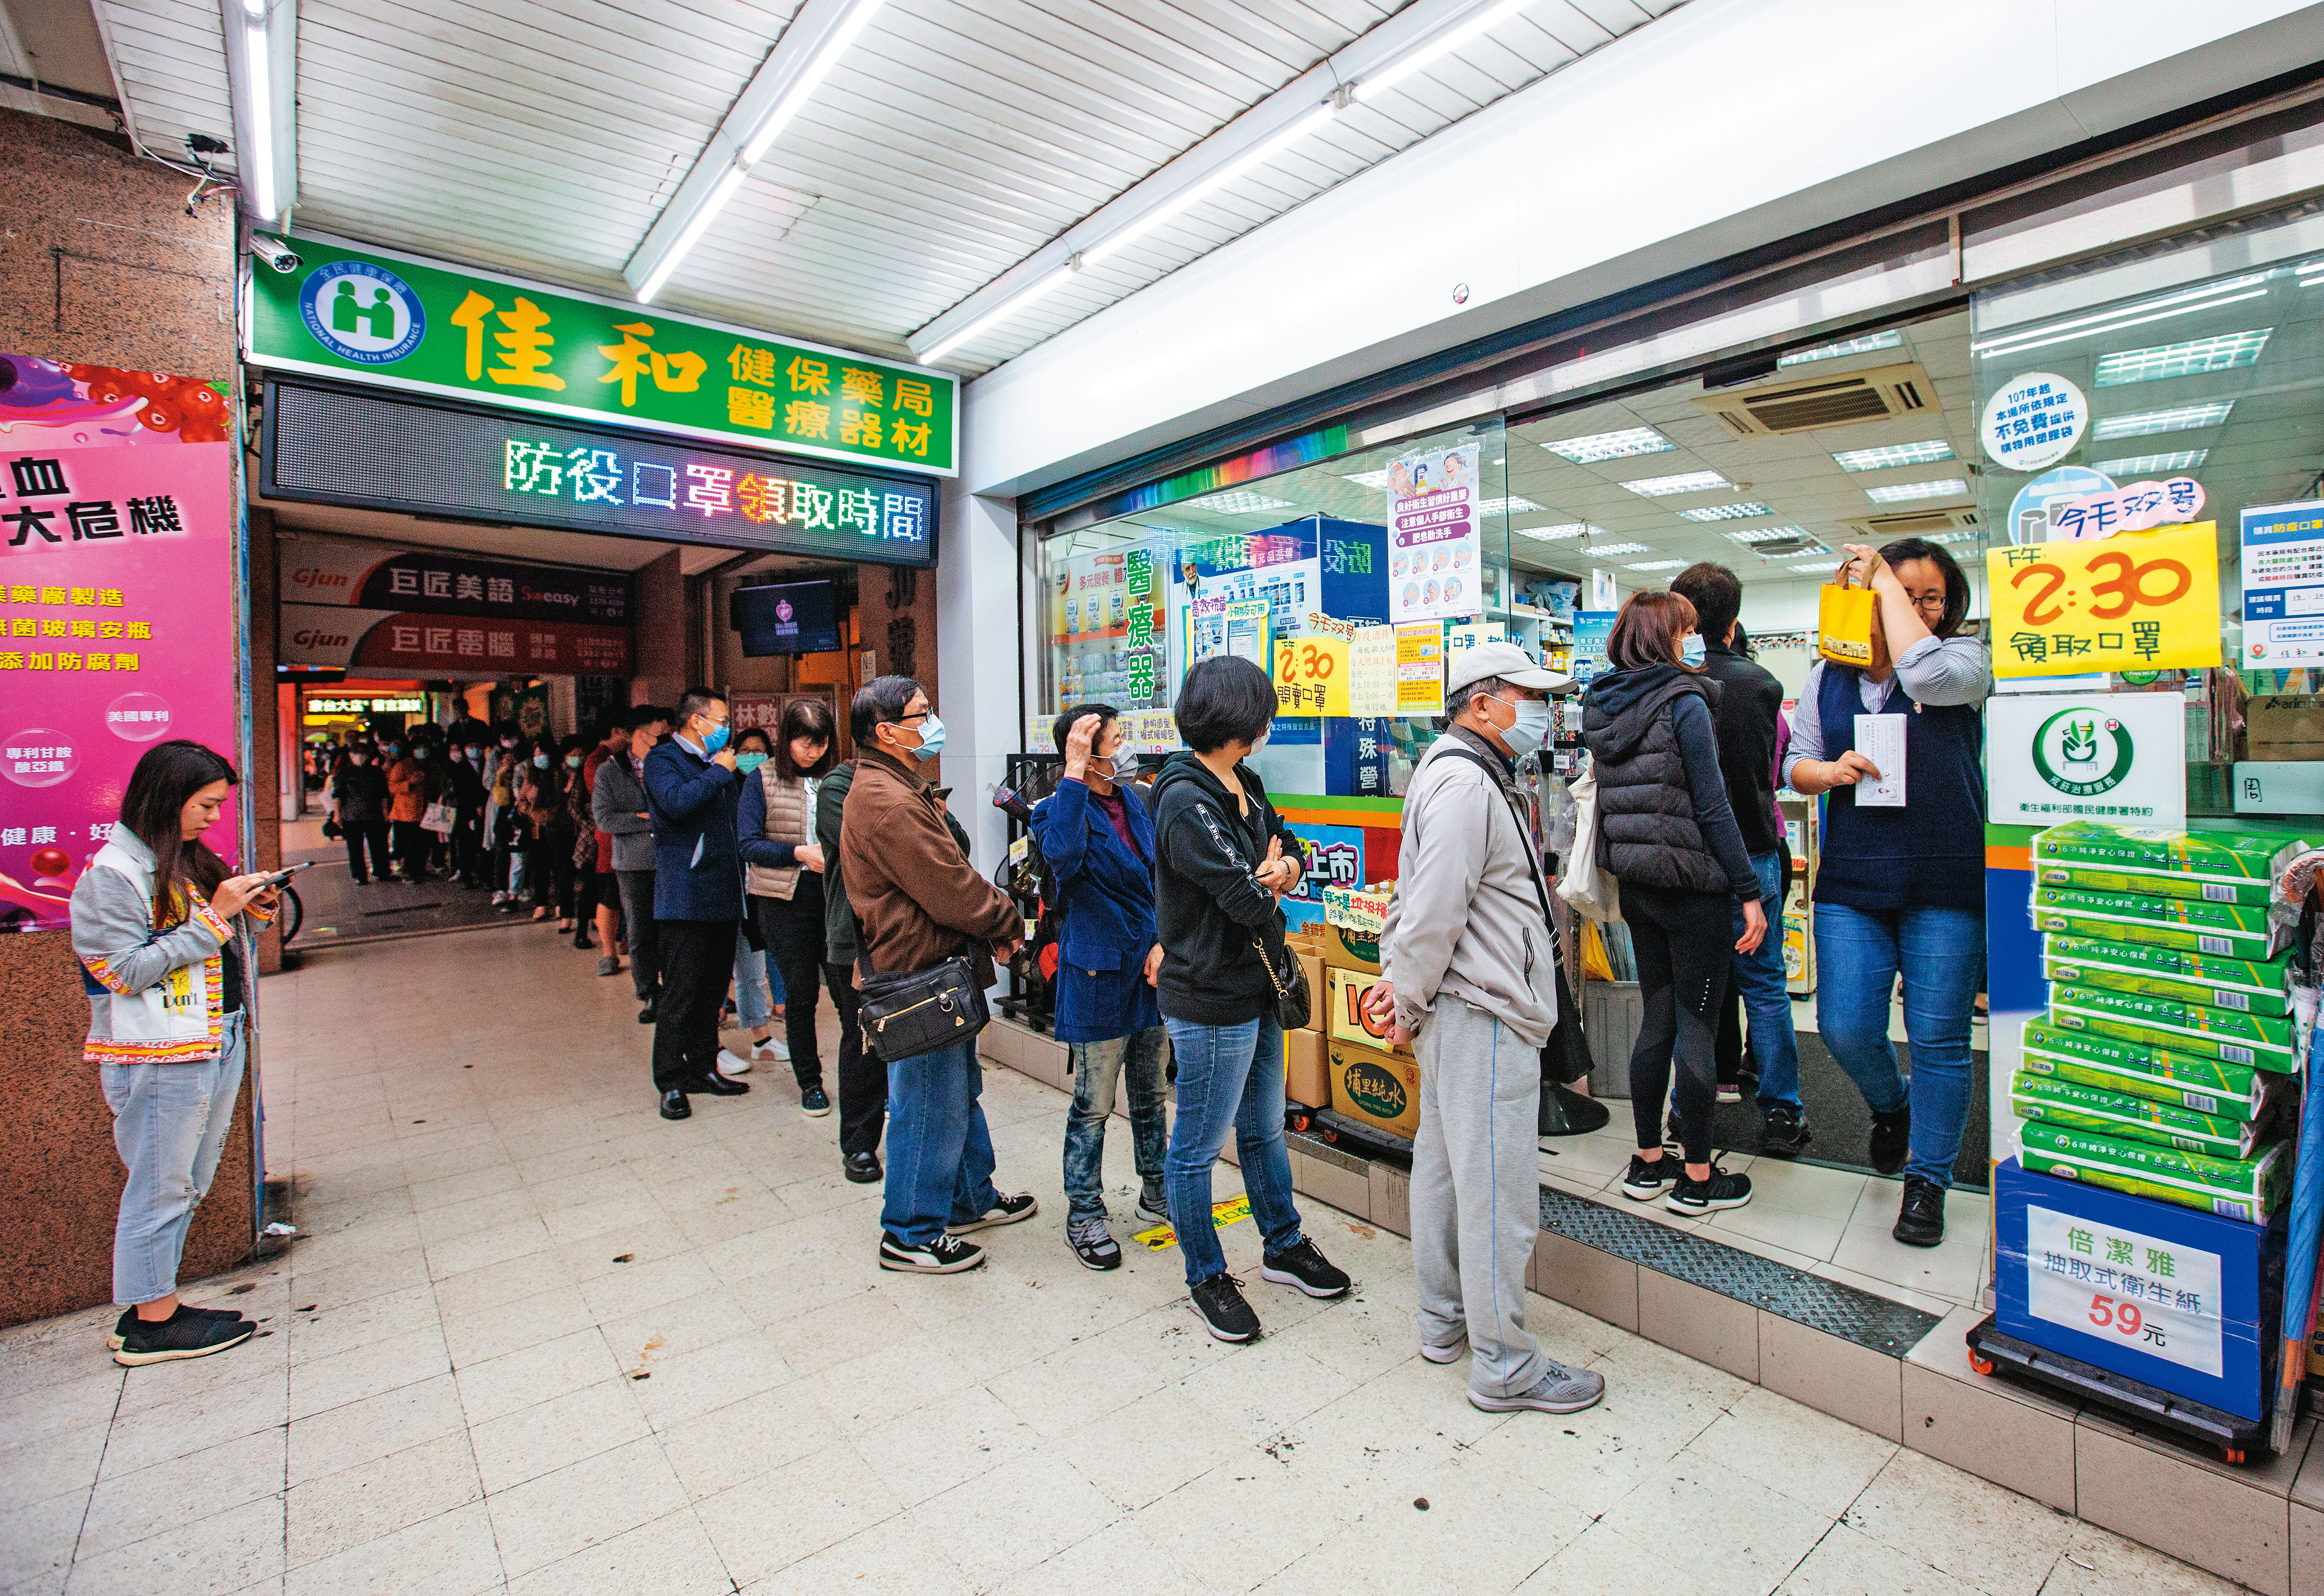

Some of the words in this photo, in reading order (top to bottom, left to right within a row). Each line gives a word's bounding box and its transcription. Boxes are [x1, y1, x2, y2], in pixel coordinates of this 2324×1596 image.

[304, 301, 335, 348] NATIONAL
[337, 345, 380, 361] HEALTH
[382, 322, 421, 361] INSURANCE
[451, 289, 707, 407] 佳和
[727, 343, 933, 417] 健保藥局
[2008, 383, 2051, 404] 107年起
[1996, 392, 2068, 422] 本場所依規定
[726, 386, 932, 456] 醫療器材
[1994, 410, 2076, 441] 不免費提供
[2001, 425, 2073, 454] 購物用塑膠袋
[0, 457, 70, 499] 血
[506, 438, 923, 542] 防役口罩領取時間
[1397, 488, 1467, 513] 良好衛生習慣好重要
[1, 496, 183, 547] 大危機
[1401, 507, 1464, 529] 注意個人手部衛生
[1413, 526, 1452, 543] 肥皂勤洗手
[2258, 545, 2324, 557] 因本藥局有配合鄰近
[2259, 554, 2324, 565] 各大醫院處方箋領藥
[292, 568, 347, 590] Gjun
[390, 567, 514, 603] 巨匠美語
[1079, 570, 1109, 590] 多元營養
[2258, 572, 2324, 582] 或離峰時段購買防疫
[0, 585, 124, 607] 藥廠製造
[2011, 551, 2192, 626] 2:30
[1192, 595, 1226, 617] 高效抗菌
[1227, 603, 1265, 618] 小朋友可用
[0, 619, 152, 640] 菌玻璃安瓶
[293, 629, 349, 650] Gjun
[1127, 548, 1154, 710] 醫療器
[391, 626, 515, 657] 巨匠電腦
[2009, 621, 2161, 663] 領取口罩
[0, 652, 140, 671] 添加防腐劑
[1279, 644, 1334, 683] 2:30
[1277, 682, 1326, 712] 開賣口罩
[107, 710, 169, 722] 美國專利
[1143, 718, 1171, 729] 動物造型
[6, 746, 72, 760] 專利甘胺
[1358, 717, 1379, 798] 特殊營
[2048, 776, 2117, 796] 戒菸治療服務
[2019, 802, 2154, 817] 衛生福利部國民健康署特約
[1209, 824, 1219, 840] NIKE
[2062, 845, 2136, 858] 6項純淨安心保證
[1307, 846, 1354, 882] 上市
[2060, 893, 2133, 908] 6項純淨安心保證
[2073, 942, 2148, 961] 6項純淨安心保證
[163, 992, 198, 1009] Don't
[2078, 992, 2154, 1013] 6項純淨安心保證
[2049, 1036, 2120, 1058] 6項純淨安心保證
[1346, 1068, 1405, 1109] 埔里純水
[2071, 1141, 2147, 1163] 6項純淨安心保證
[2067, 1226, 2175, 1278] 倍潔雅
[2044, 1251, 2201, 1315] 抽取式衛生紙
[2089, 1295, 2166, 1347] 59元
